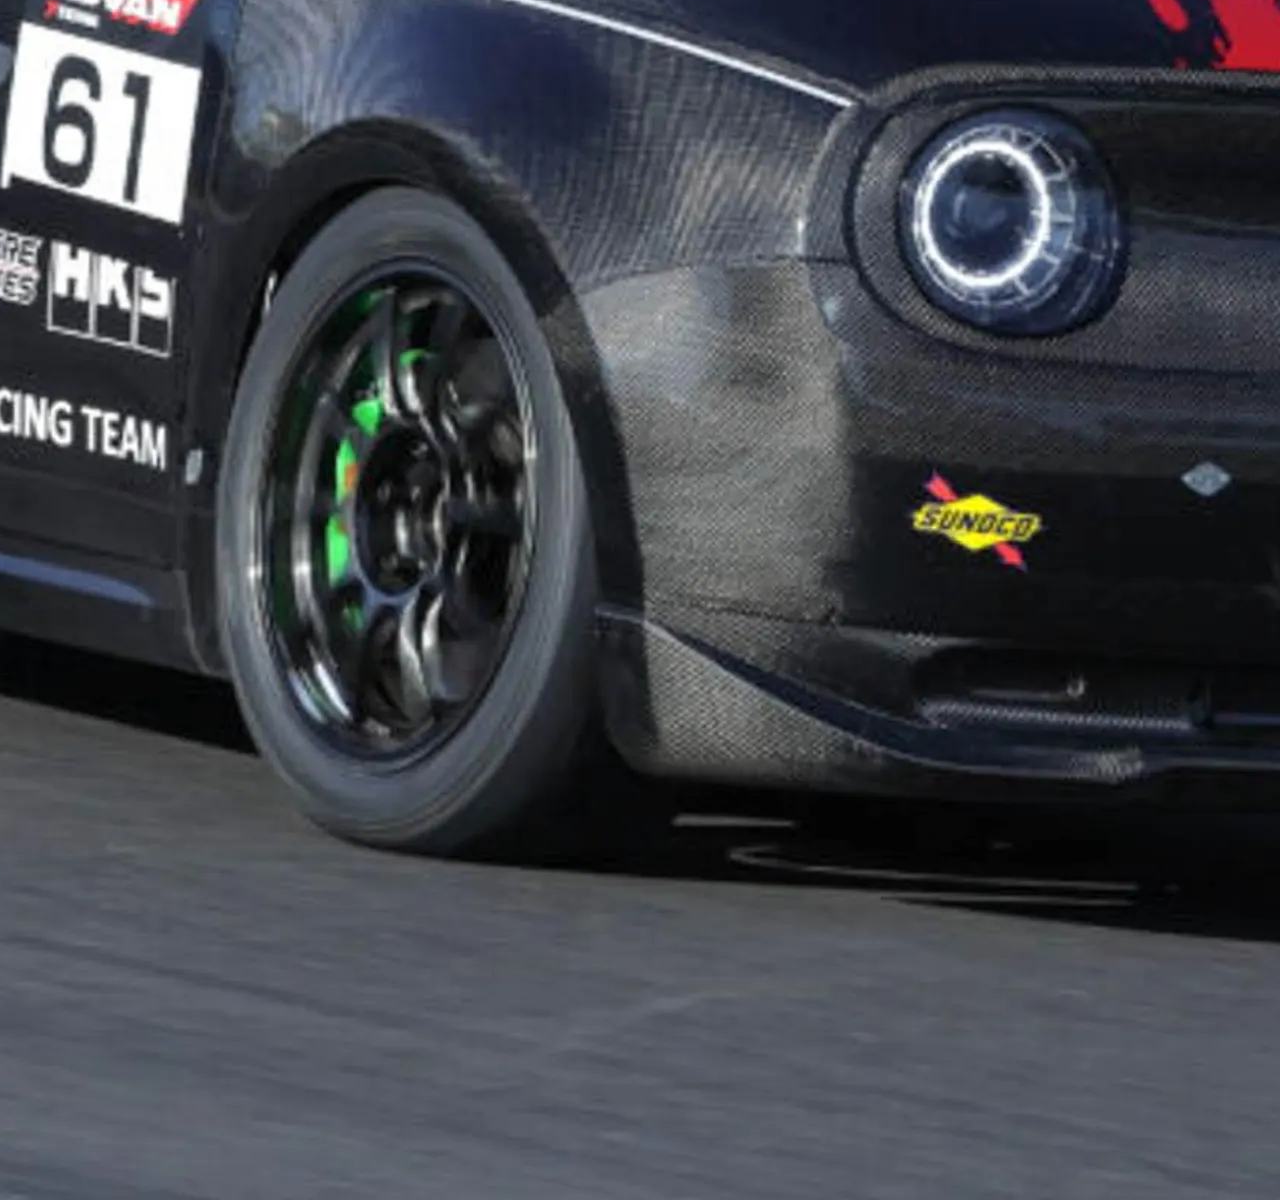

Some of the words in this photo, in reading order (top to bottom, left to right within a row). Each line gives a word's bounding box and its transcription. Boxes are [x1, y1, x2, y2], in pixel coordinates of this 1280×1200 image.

[42, 54, 152, 203] 61
[51, 241, 171, 320] HKS
[81, 405, 166, 471] TEAM
[918, 506, 1034, 538] SUNOCO
